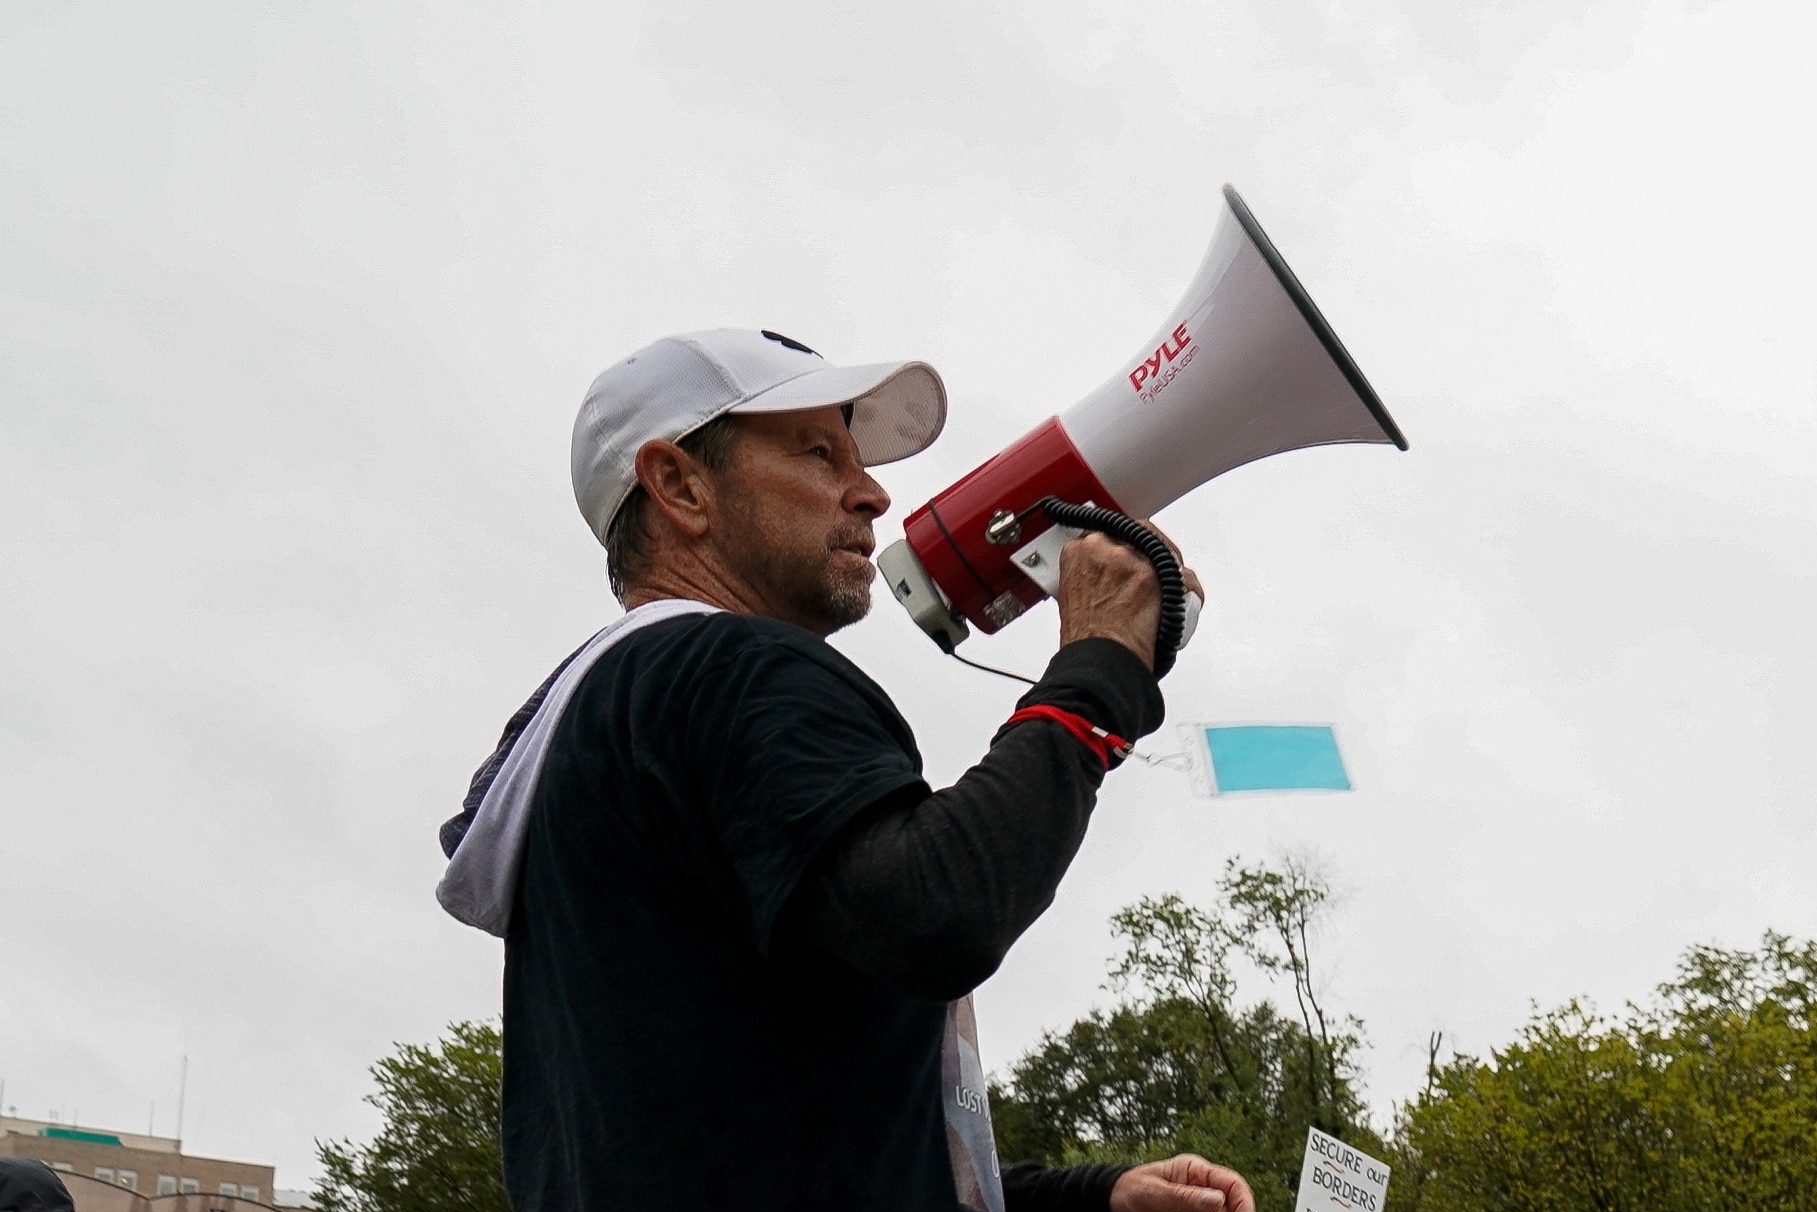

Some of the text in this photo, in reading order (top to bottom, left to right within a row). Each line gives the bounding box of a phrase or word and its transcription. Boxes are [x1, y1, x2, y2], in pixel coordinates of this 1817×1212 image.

[1129, 320, 1192, 392] PYLE
[955, 1085, 983, 1115] LOST
[1311, 1134, 1388, 1186] SECURE our
[1312, 1166, 1376, 1212] BORDERS
